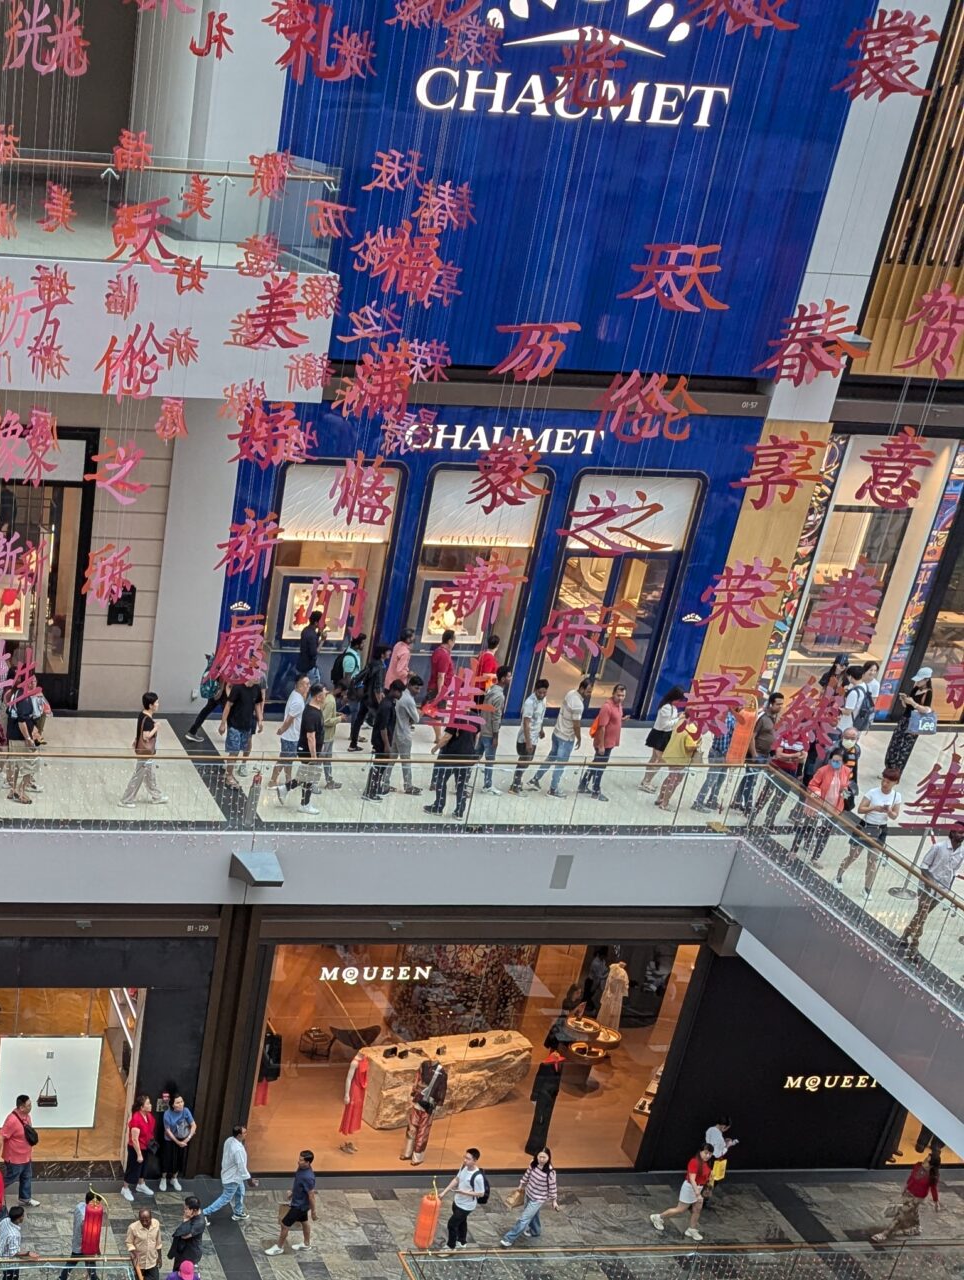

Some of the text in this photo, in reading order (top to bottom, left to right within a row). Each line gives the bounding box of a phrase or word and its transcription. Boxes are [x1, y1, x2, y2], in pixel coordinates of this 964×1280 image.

[416, 67, 730, 127] CHAUMET
[244, 274, 309, 349] 美
[405, 424, 604, 455] CHAUMET
[855, 430, 934, 509] 意
[556, 494, 624, 556] 之
[606, 490, 673, 551] 之
[918, 720, 935, 731] Lee
